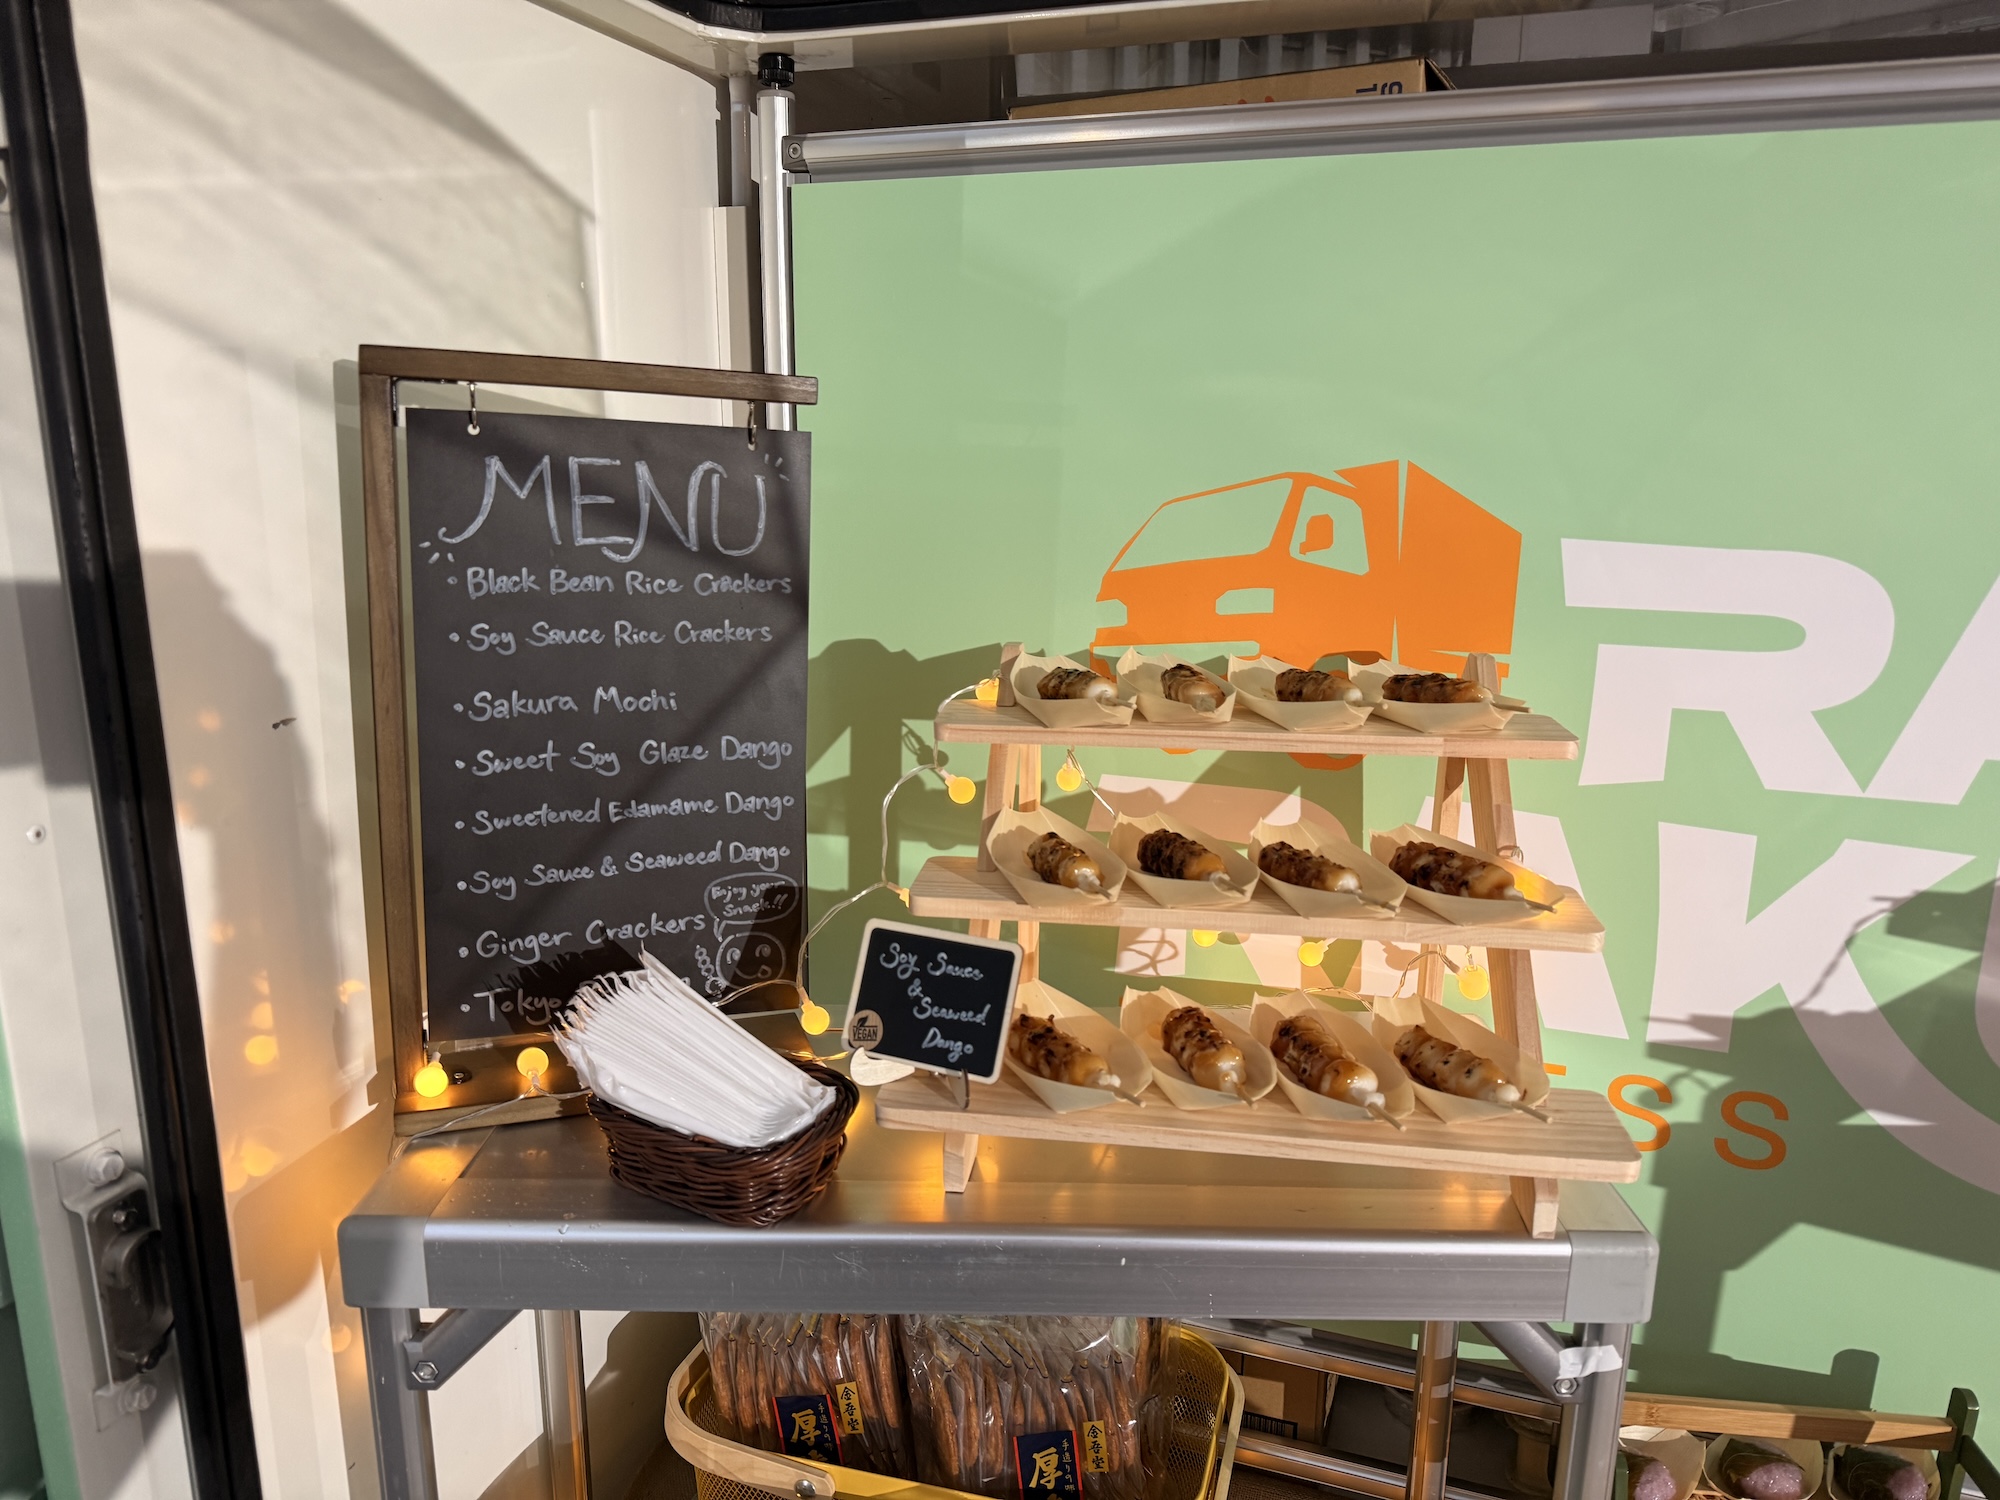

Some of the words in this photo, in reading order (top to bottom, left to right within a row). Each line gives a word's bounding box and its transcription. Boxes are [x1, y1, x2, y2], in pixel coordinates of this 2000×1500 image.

[438, 454, 767, 563] MENU
[466, 566, 541, 600] Black
[549, 567, 615, 596] Bean
[625, 570, 684, 596] Rice
[693, 571, 793, 597] Crackers
[466, 622, 517, 656] Soy
[525, 620, 606, 648] Sauce
[614, 619, 667, 648] Rice
[673, 618, 774, 645] Crackers
[467, 689, 579, 723] Sakura
[593, 685, 678, 715] Mochi
[471, 740, 562, 777] Sweet
[569, 741, 621, 777] Soy
[638, 738, 709, 766] Glaze
[720, 735, 793, 770] Dango
[471, 797, 601, 836] Sweetened
[608, 798, 718, 824] Edamame
[724, 790, 795, 821] Dango
[468, 870, 518, 901] Soy
[523, 863, 596, 888] Sauce
[598, 855, 620, 877] &
[624, 839, 723, 874] Seaweed
[728, 840, 791, 873] Dango
[711, 885, 748, 903] Enjoy
[750, 880, 786, 898] your
[475, 930, 573, 965] Ginger
[584, 911, 707, 946] Crackers
[879, 942, 920, 980] Soy
[926, 951, 984, 981] Sauce
[473, 987, 563, 1026] Tokyo
[906, 977, 924, 998] &
[912, 995, 992, 1026] Seaweed
[852, 1026, 878, 1041] VEGAN
[921, 1026, 974, 1063] Dango
[840, 1386, 860, 1432] 金吾堂
[1087, 1424, 1105, 1470] 金吾堂
